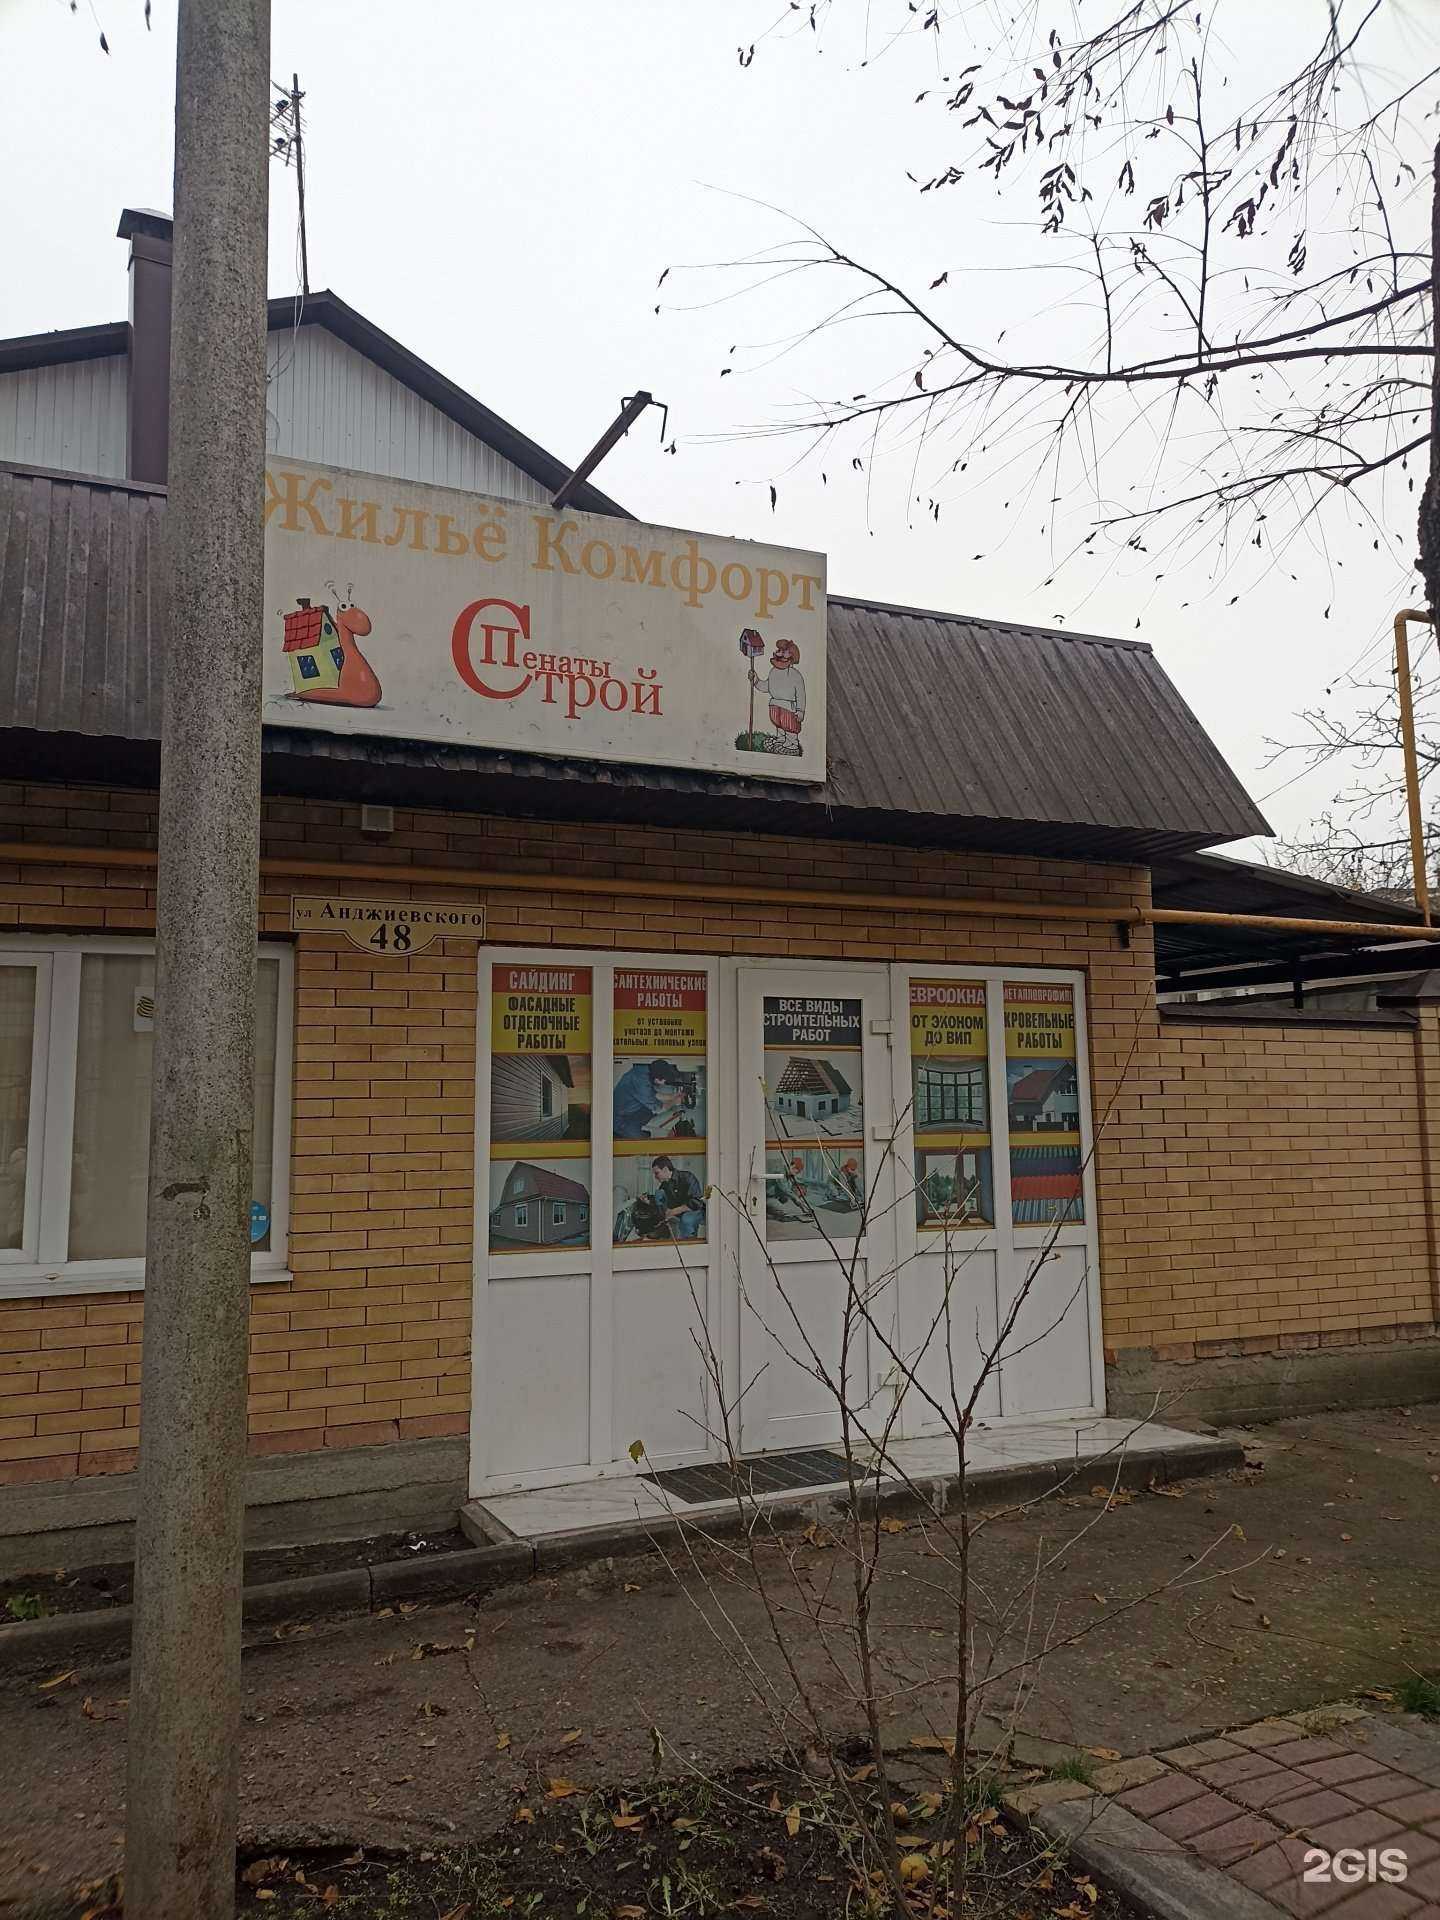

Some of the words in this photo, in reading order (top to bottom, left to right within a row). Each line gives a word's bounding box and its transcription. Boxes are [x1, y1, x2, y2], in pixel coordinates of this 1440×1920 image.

[264, 471, 507, 563] Жильё
[531, 514, 822, 619] Комфорт
[451, 597, 664, 720] Строй
[479, 622, 612, 680] Пенаты
[296, 907, 313, 921] ул
[320, 902, 482, 927] Анджиевского
[369, 923, 412, 952] 48
[509, 969, 576, 992] САЙДИНГ
[637, 992, 683, 1008] РАБОТЫ
[911, 987, 986, 1005] ЕВРООКНА
[508, 996, 576, 1015] ФАСАДНЫЕ
[779, 999, 803, 1012] ВСЕ
[806, 1000, 843, 1015] ВИДЫ
[503, 1014, 580, 1032] ОТДЕЛОЧНЫЕ
[763, 1013, 860, 1028] СТРОИТЕЛЬНЫХ
[911, 1014, 929, 1028] ОТ
[932, 1015, 983, 1029] ЭКОНОМ
[1004, 1011, 1074, 1029] КРОВЕЛЬНЫЕ
[517, 1033, 566, 1049] РАБОТЫ
[792, 1029, 832, 1041] РАБОТ
[925, 1030, 942, 1046] ДО
[946, 1031, 972, 1045] ВИП
[1017, 1032, 1063, 1049] РАБОТЫ
